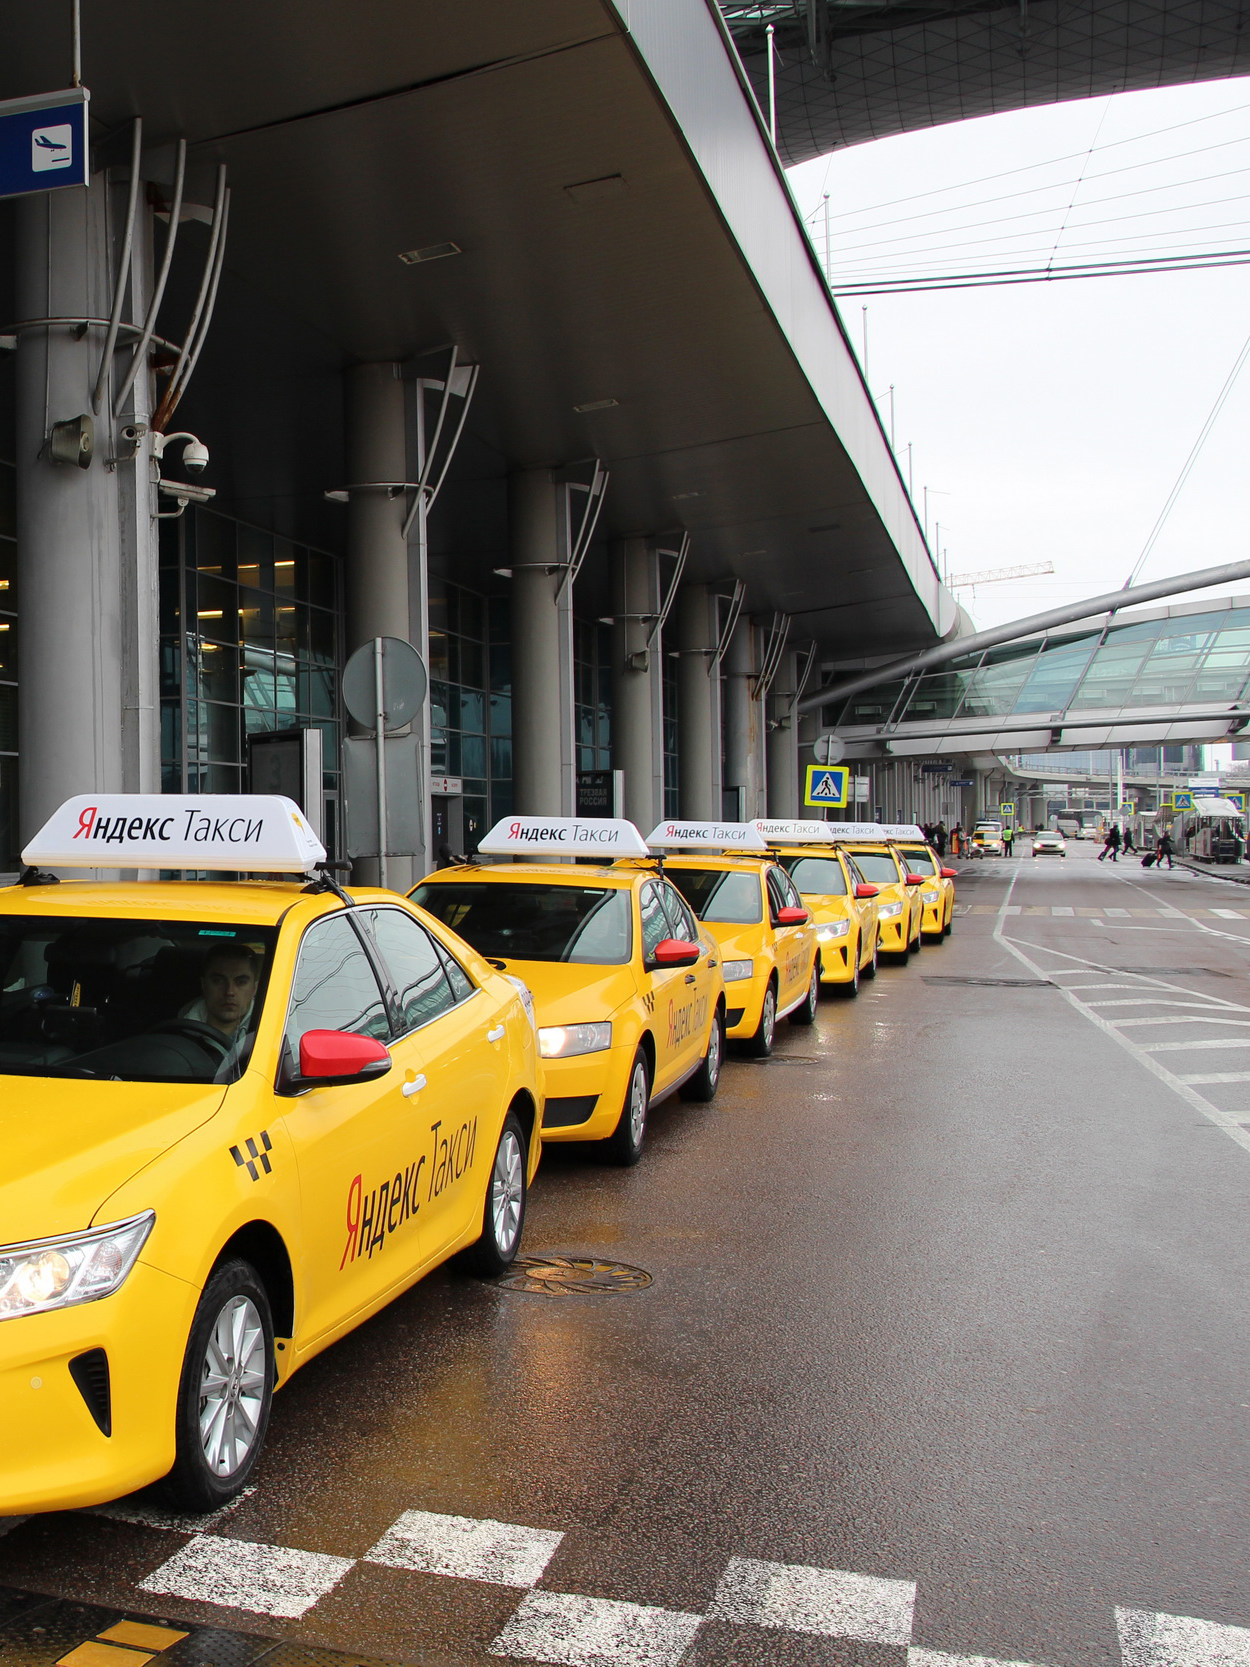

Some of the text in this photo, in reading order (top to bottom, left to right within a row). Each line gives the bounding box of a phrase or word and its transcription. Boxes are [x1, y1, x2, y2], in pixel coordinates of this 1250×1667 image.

[580, 788, 608, 797] ТРЕЗВАЯ
[579, 797, 608, 806] РОССИЯ
[72, 807, 264, 844] Яндекс Такси
[756, 822, 820, 834] Яндекс Такси
[852, 825, 875, 835] Такси
[507, 822, 619, 843] Яндекс Такси
[665, 825, 747, 840] Яндекс Такси
[339, 1115, 478, 1272] Яндекс Такси
